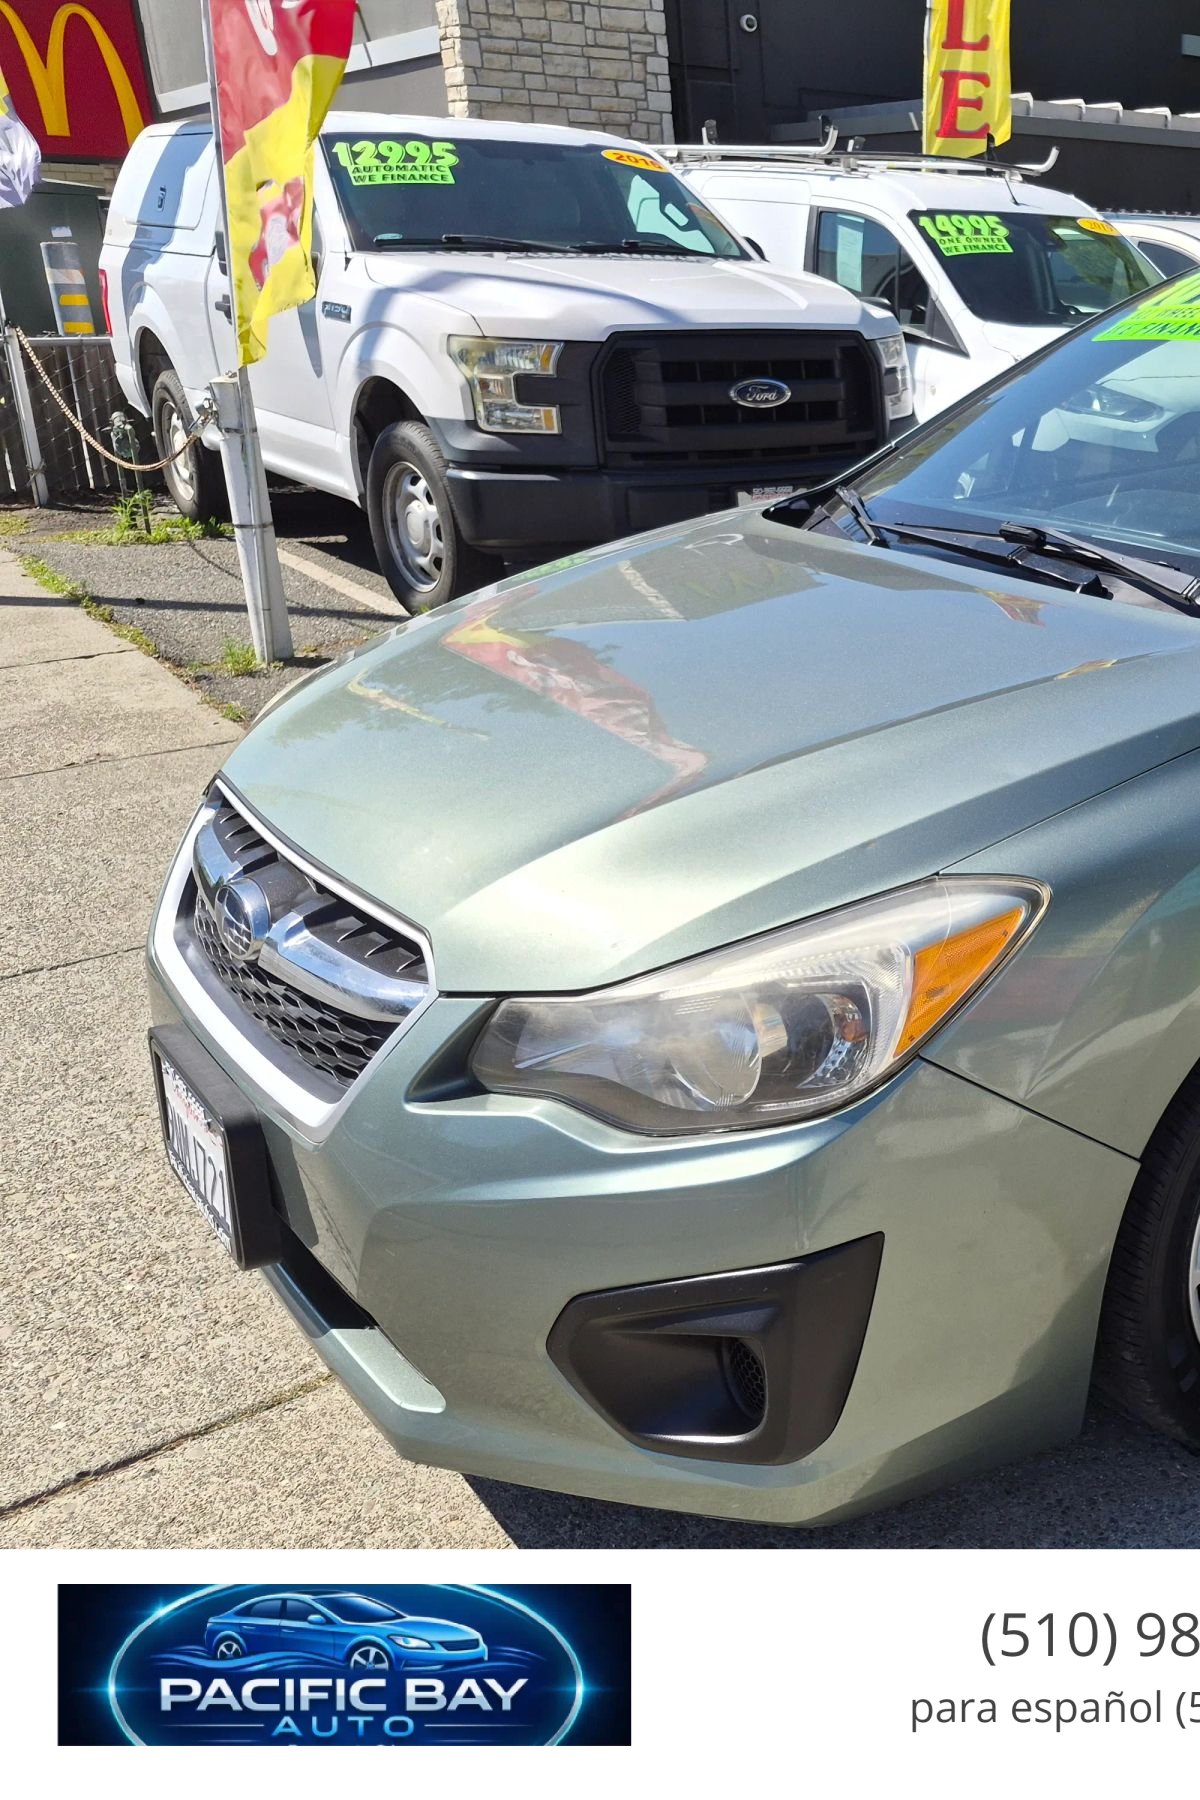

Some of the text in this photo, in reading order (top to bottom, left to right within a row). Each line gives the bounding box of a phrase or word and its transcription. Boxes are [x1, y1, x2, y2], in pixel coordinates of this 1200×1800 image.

[332, 141, 459, 167] 12995
[352, 164, 446, 174] AUTOMATIC
[353, 173, 449, 182] WE FINANCE
[919, 215, 1009, 238] 14995
[940, 237, 961, 245] ONE
[943, 245, 961, 253] WE
[746, 385, 779, 401] Ford
